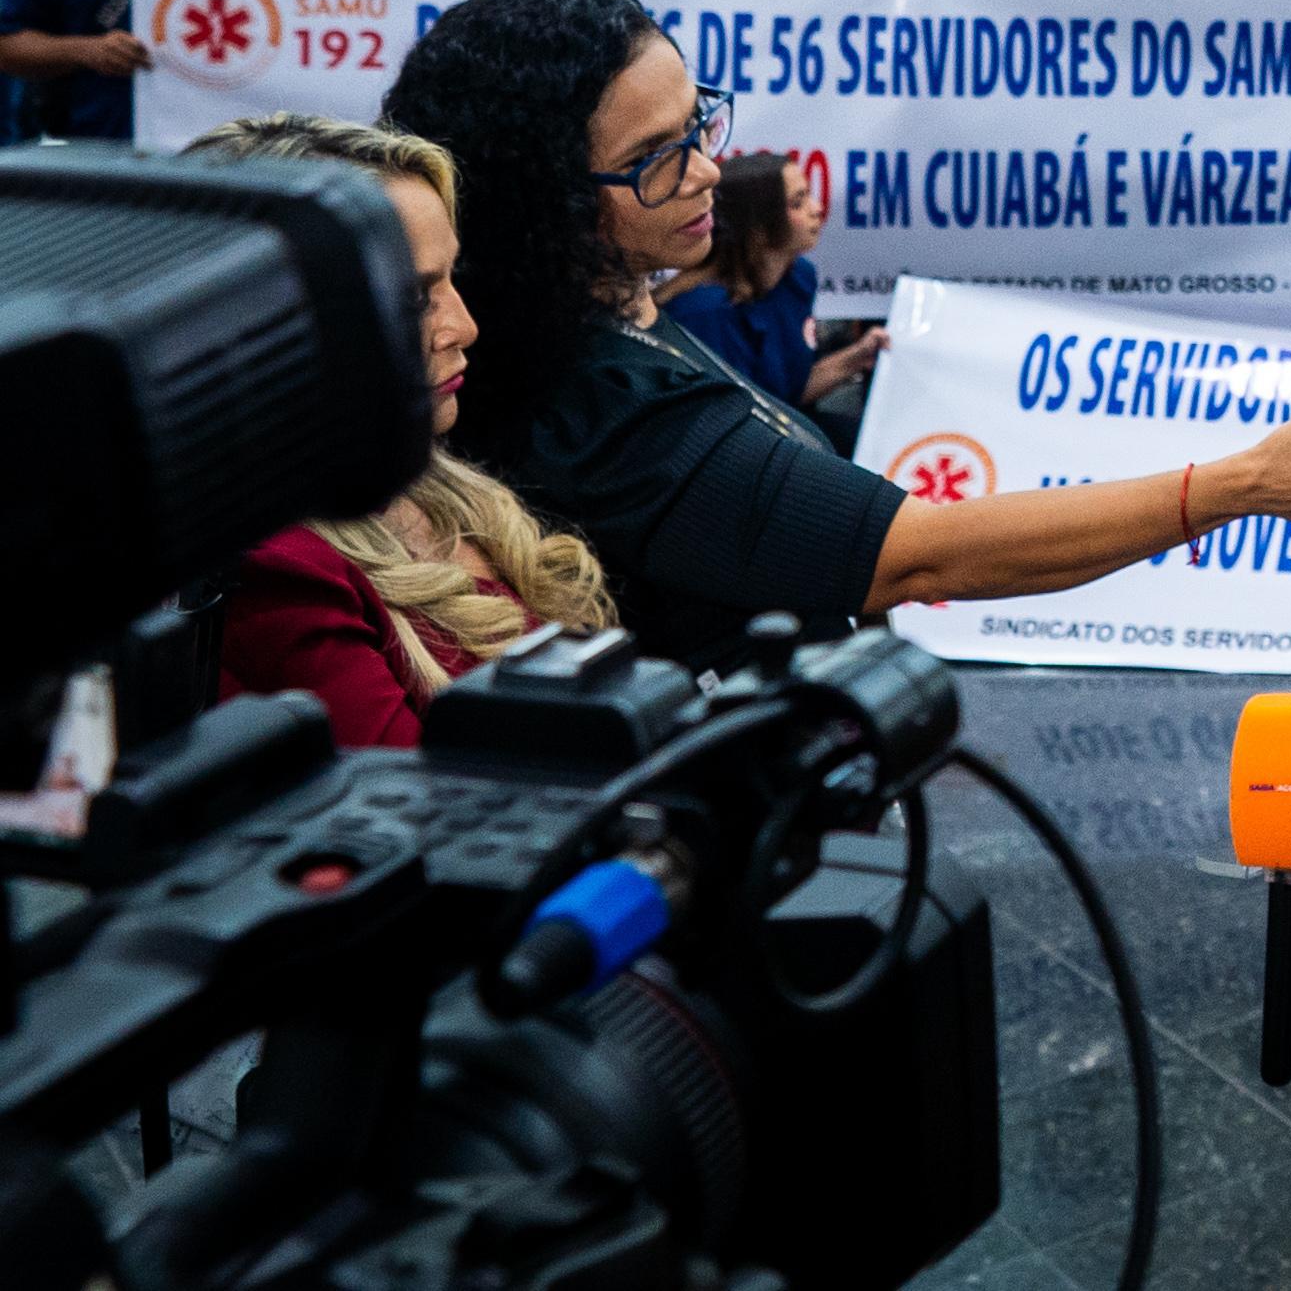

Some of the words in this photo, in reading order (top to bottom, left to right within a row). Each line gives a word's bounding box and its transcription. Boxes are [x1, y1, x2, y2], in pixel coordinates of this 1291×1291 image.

[296, 29, 385, 70] 192
[697, 10, 753, 93] DE
[770, 14, 824, 93] 56
[838, 15, 1118, 99] SERVIDORES
[1131, 19, 1193, 99] DO
[846, 150, 910, 230] EM
[924, 134, 1093, 230] CUIABÁ
[1106, 150, 1128, 228] E
[1107, 273, 1173, 294] MATO
[1178, 273, 1277, 294] GROSSO
[1019, 331, 1077, 413] OS
[980, 615, 1114, 643] SINDICATO
[1122, 623, 1174, 647] DOS
